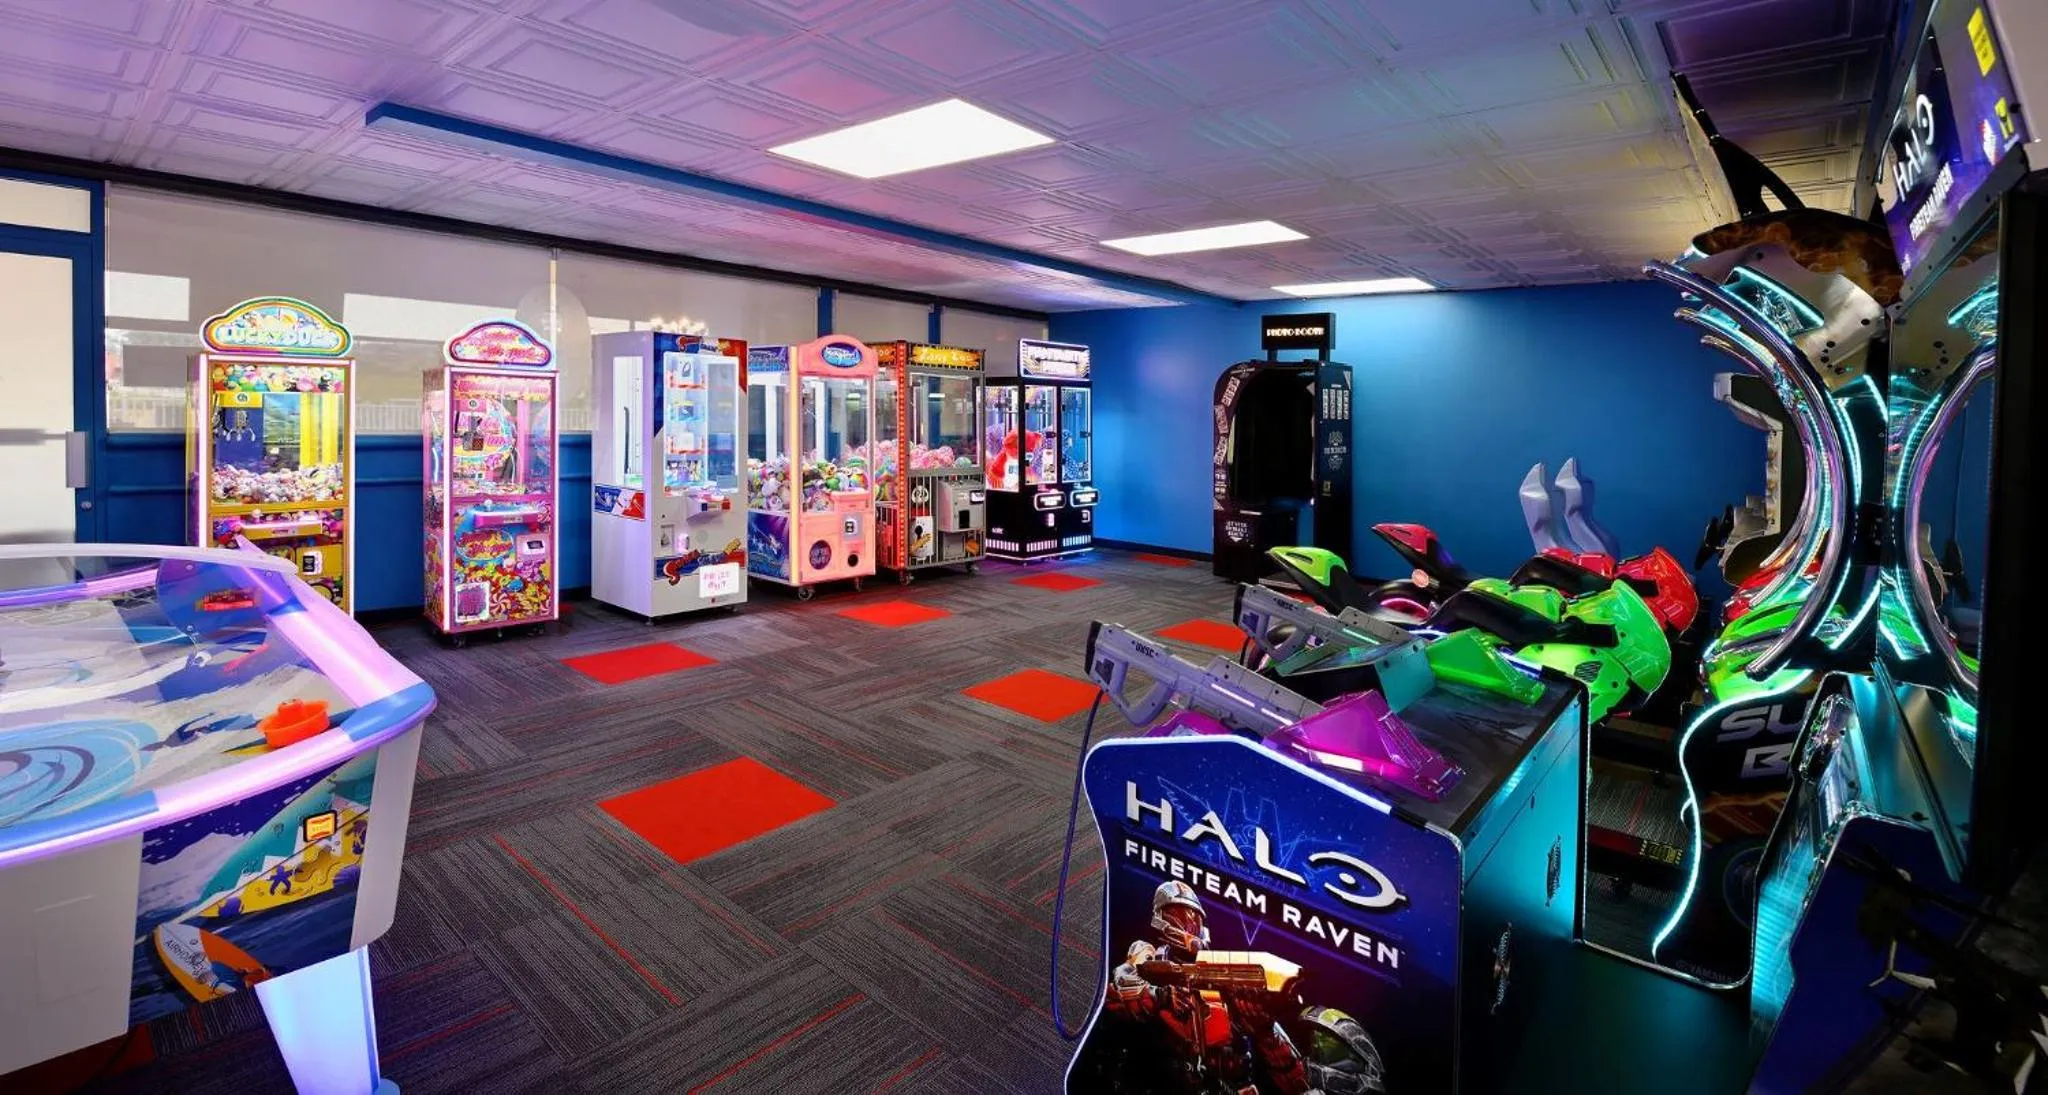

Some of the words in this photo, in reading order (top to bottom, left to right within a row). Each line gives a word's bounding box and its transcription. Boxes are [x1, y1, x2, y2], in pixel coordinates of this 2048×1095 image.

[1266, 328, 1294, 337] PHOTO
[1294, 327, 1324, 336] BOOTH
[1717, 700, 1814, 742] SU
[1740, 742, 1794, 779] B
[1126, 780, 1407, 908] HALO
[1125, 838, 1266, 914] FIRETEAM
[1282, 903, 1399, 969] RAVEN
